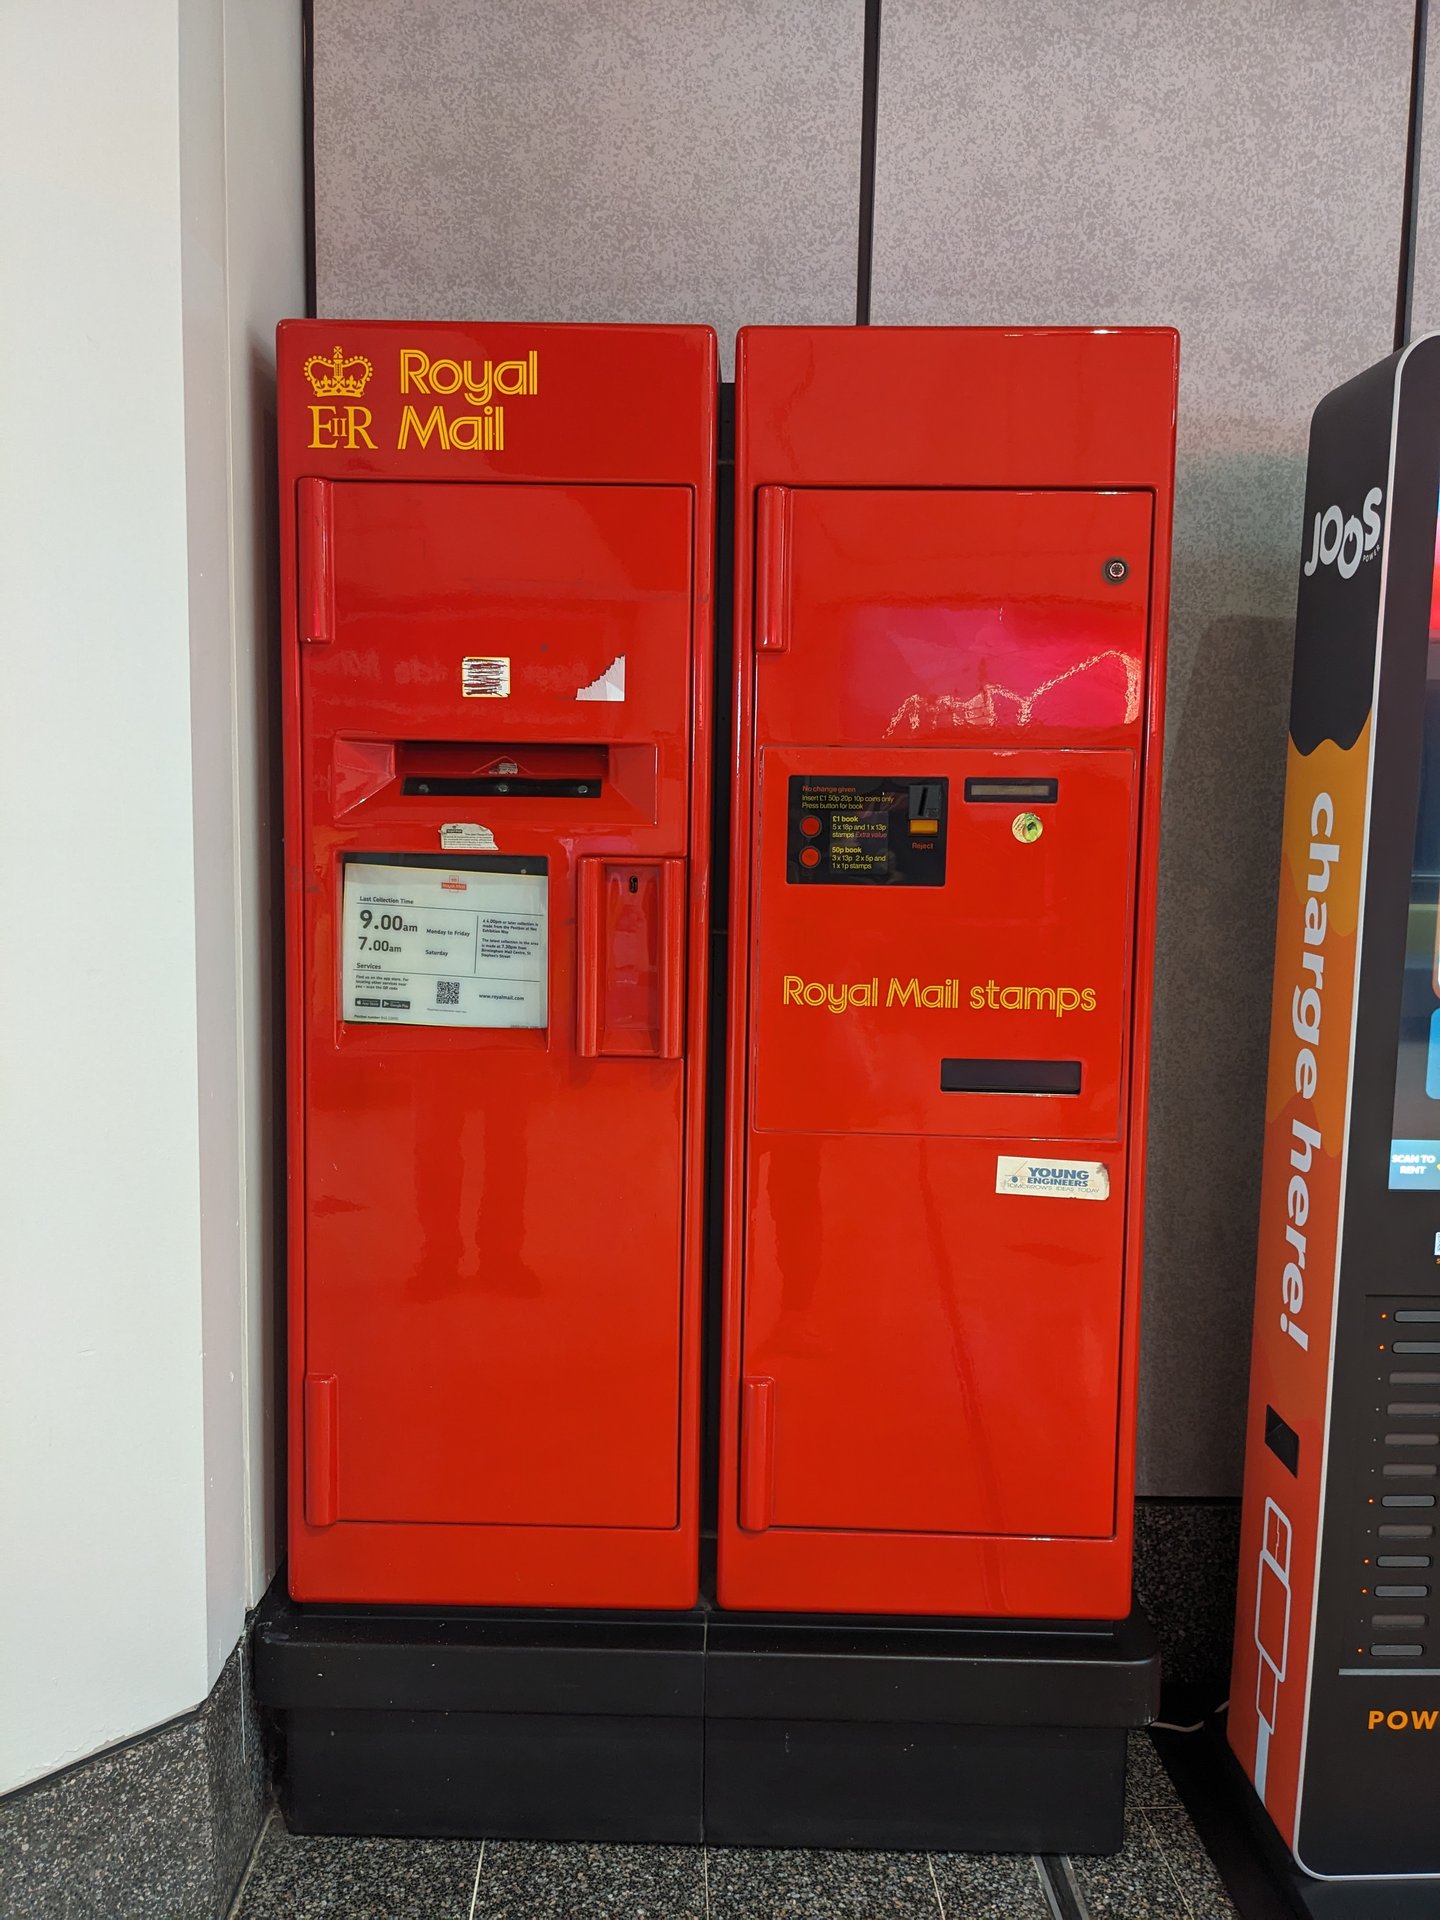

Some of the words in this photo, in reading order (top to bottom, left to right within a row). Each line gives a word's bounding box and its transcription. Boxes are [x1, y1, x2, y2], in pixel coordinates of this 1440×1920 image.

[400, 349, 538, 406] Royal
[398, 405, 504, 451] Mail
[1304, 486, 1382, 580] JOOS
[360, 910, 418, 932] 9.00am
[358, 936, 402, 952] 7.00am
[1292, 792, 1340, 1100] charge
[783, 975, 879, 1014] Royal
[886, 977, 959, 1009] Mail
[970, 980, 1096, 1018] stamps
[1028, 1167, 1090, 1180] YOUNG
[1392, 1154, 1420, 1163] SCAN
[1420, 1154, 1436, 1164] TO
[1400, 1165, 1427, 1174] RENT
[1027, 1177, 1088, 1187] ENGINEERS
[1280, 1118, 1322, 1352] here!
